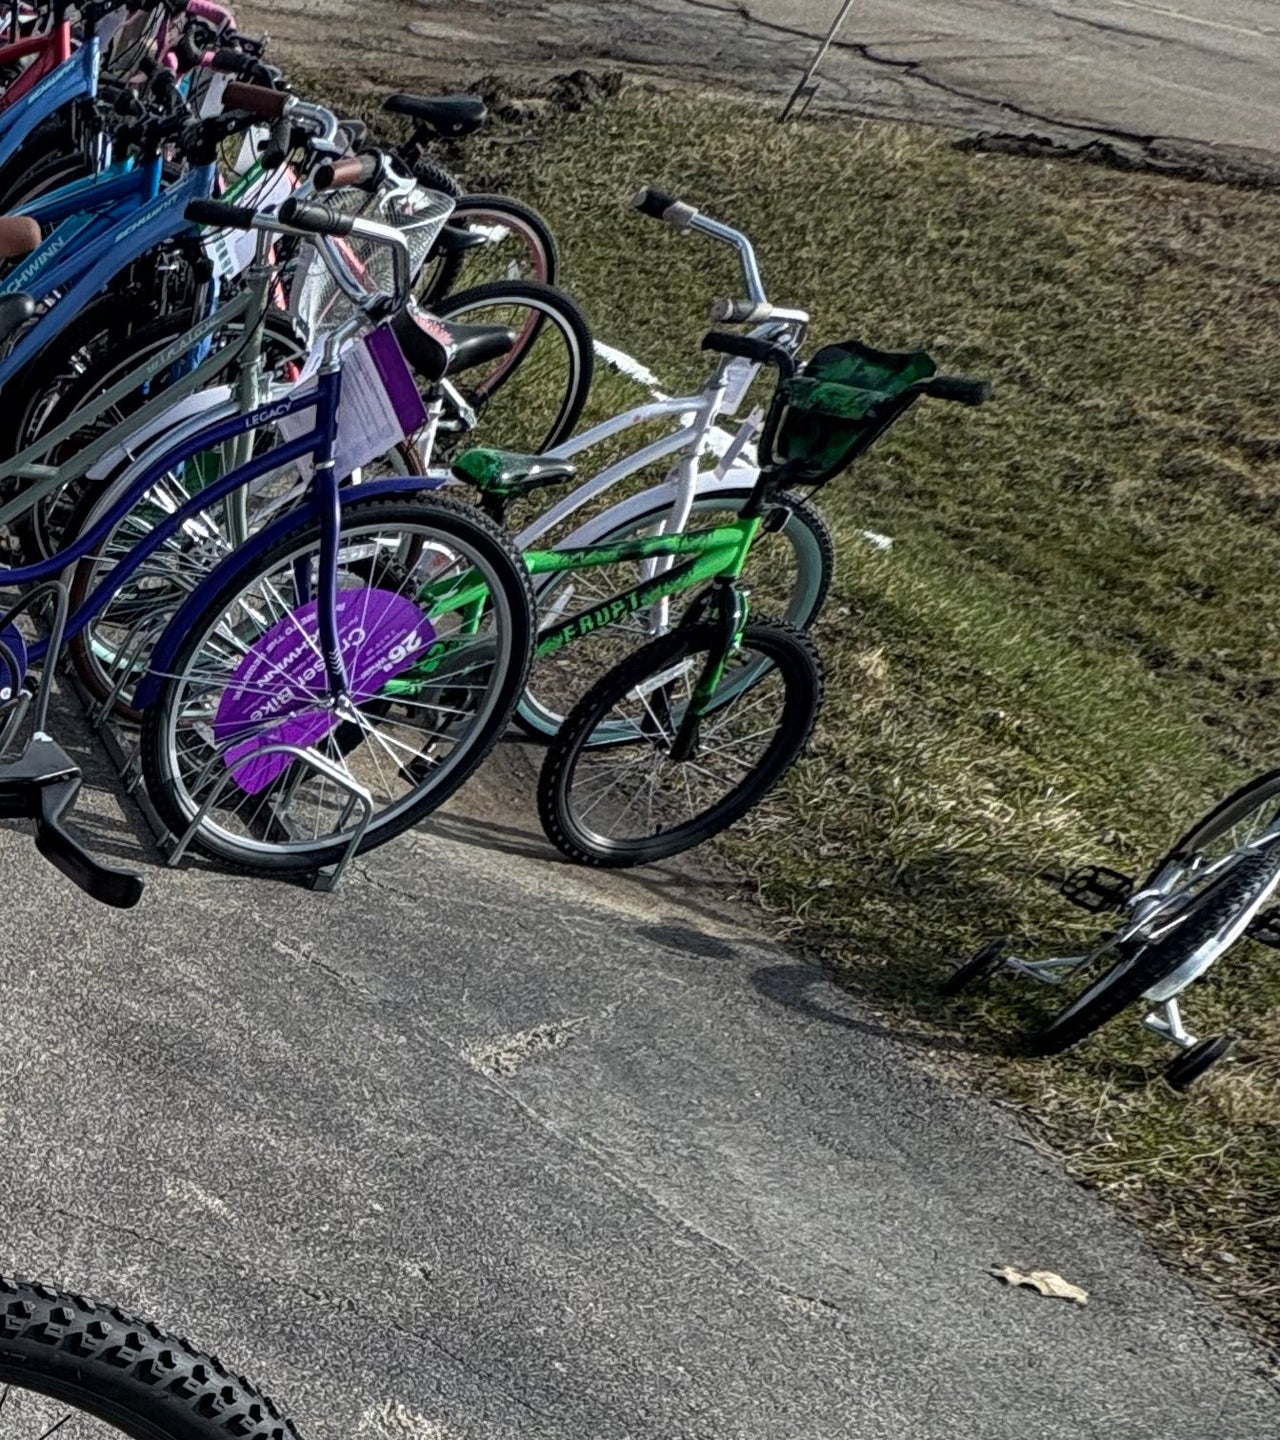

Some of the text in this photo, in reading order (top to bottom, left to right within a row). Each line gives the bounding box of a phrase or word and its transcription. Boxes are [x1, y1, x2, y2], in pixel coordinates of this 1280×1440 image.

[3, 235, 66, 295] CHWINN
[244, 399, 292, 429] LEGACY
[563, 590, 641, 642] ERUPT
[298, 627, 366, 687] Crser
[250, 686, 296, 721] Bike
